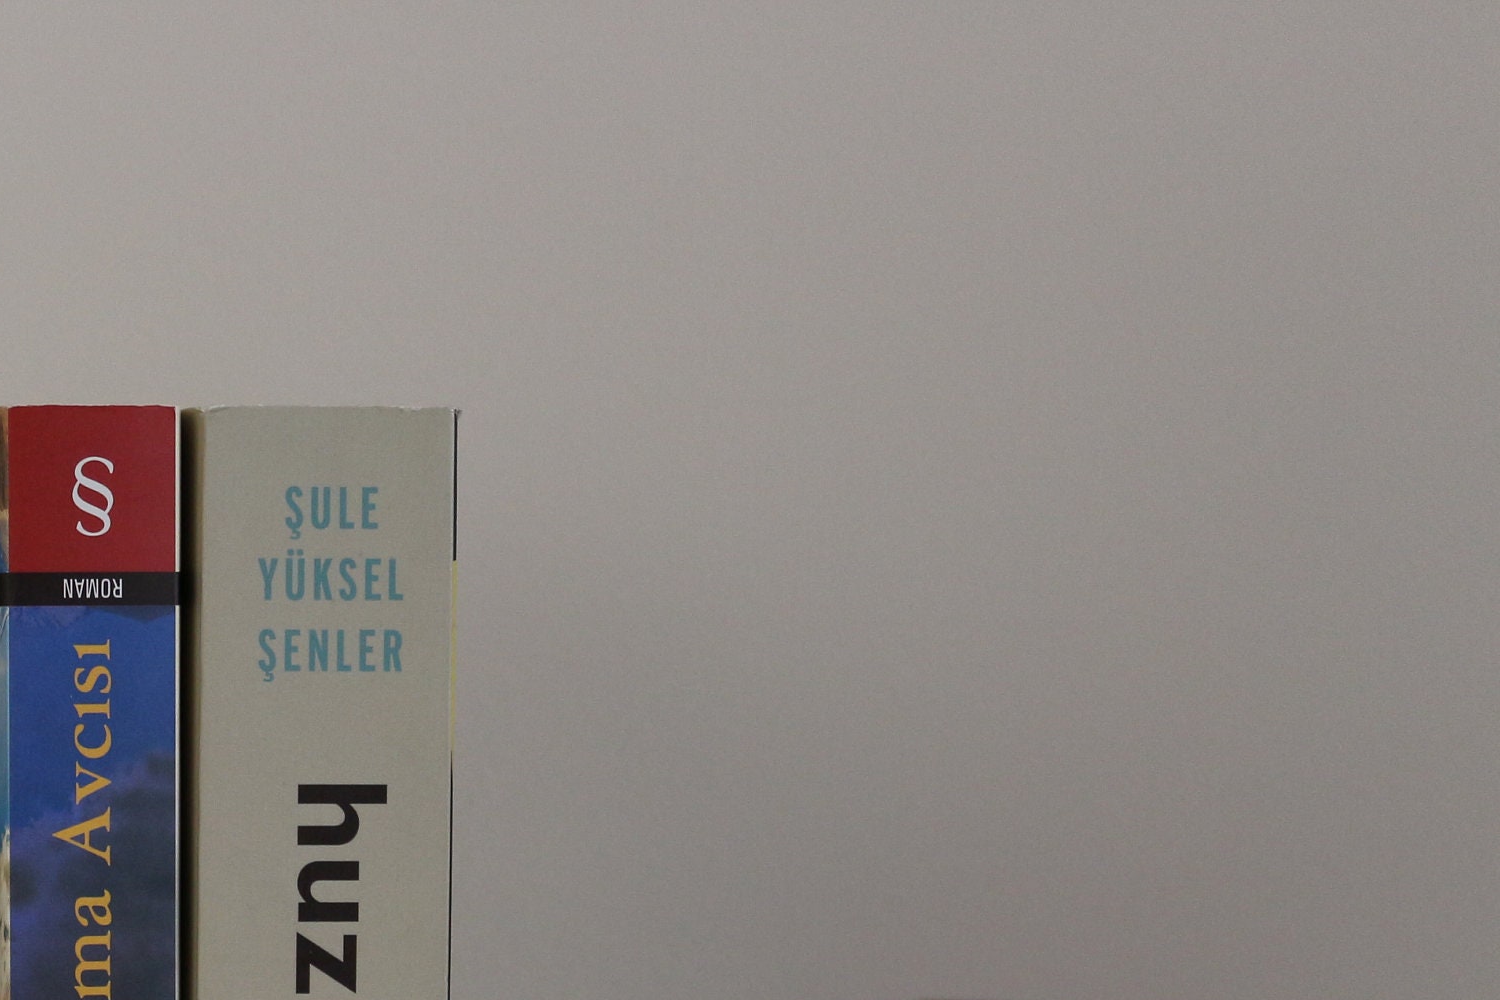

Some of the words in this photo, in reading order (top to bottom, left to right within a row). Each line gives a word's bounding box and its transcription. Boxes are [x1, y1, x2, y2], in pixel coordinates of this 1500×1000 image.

[285, 486, 378, 540] ŞULE
[63, 578, 123, 599] ROMAN
[258, 548, 404, 601] YÜKSEL
[258, 629, 403, 682] ŞENLER
